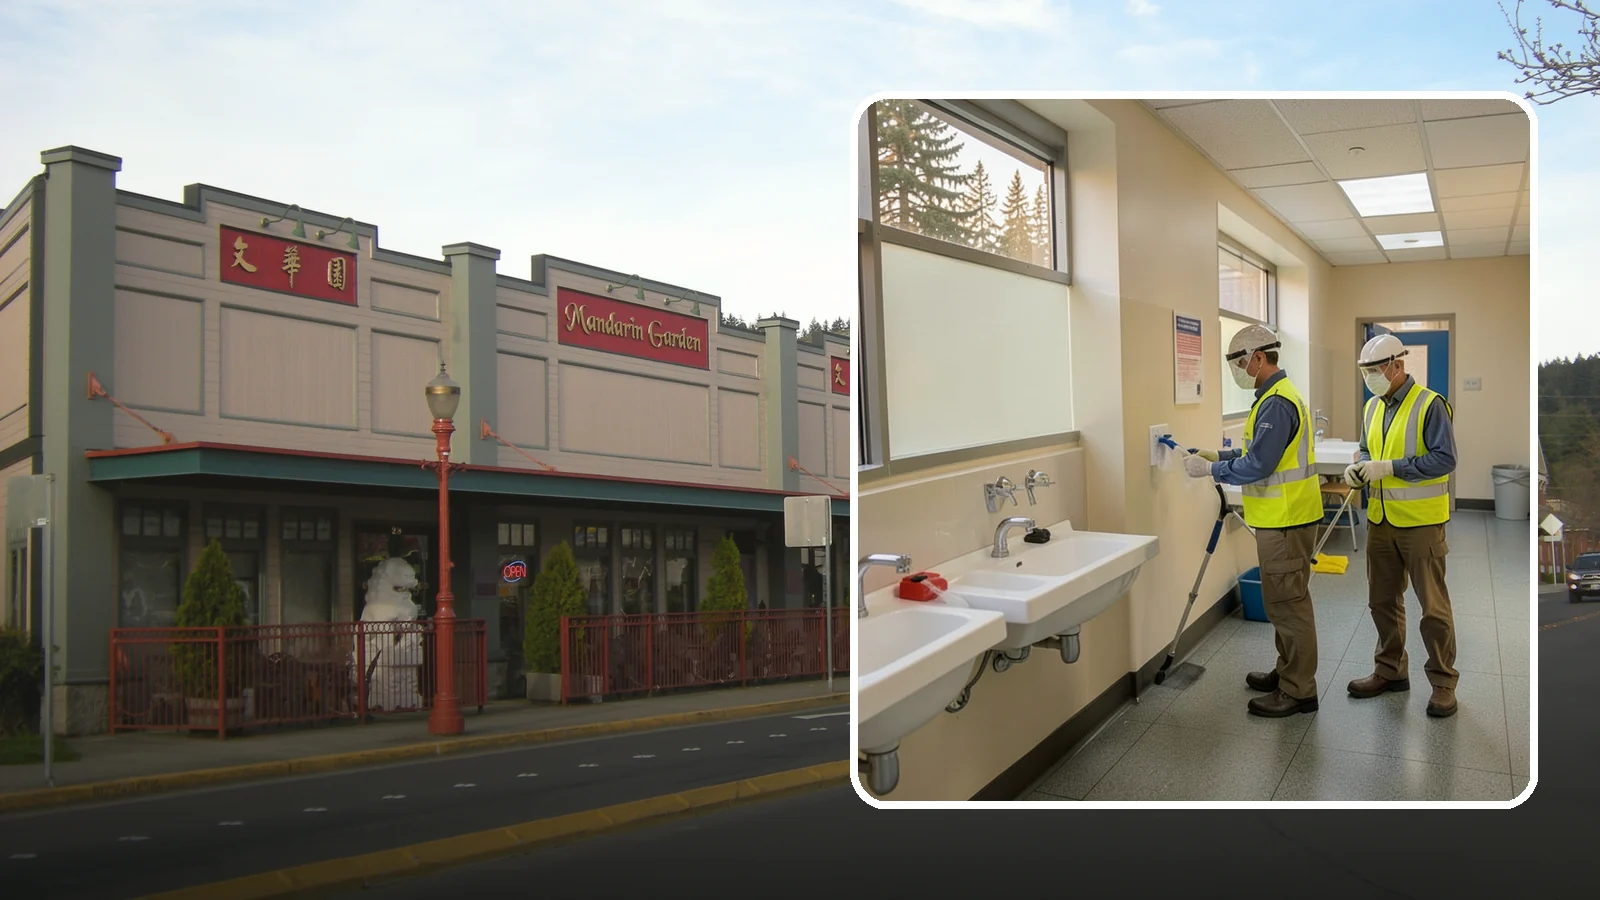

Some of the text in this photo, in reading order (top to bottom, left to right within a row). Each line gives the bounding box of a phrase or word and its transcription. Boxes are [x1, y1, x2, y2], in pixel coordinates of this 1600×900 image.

[231, 235, 346, 291] 文華園
[564, 302, 701, 351] Mandarin Garden
[503, 565, 527, 578] OPEN
